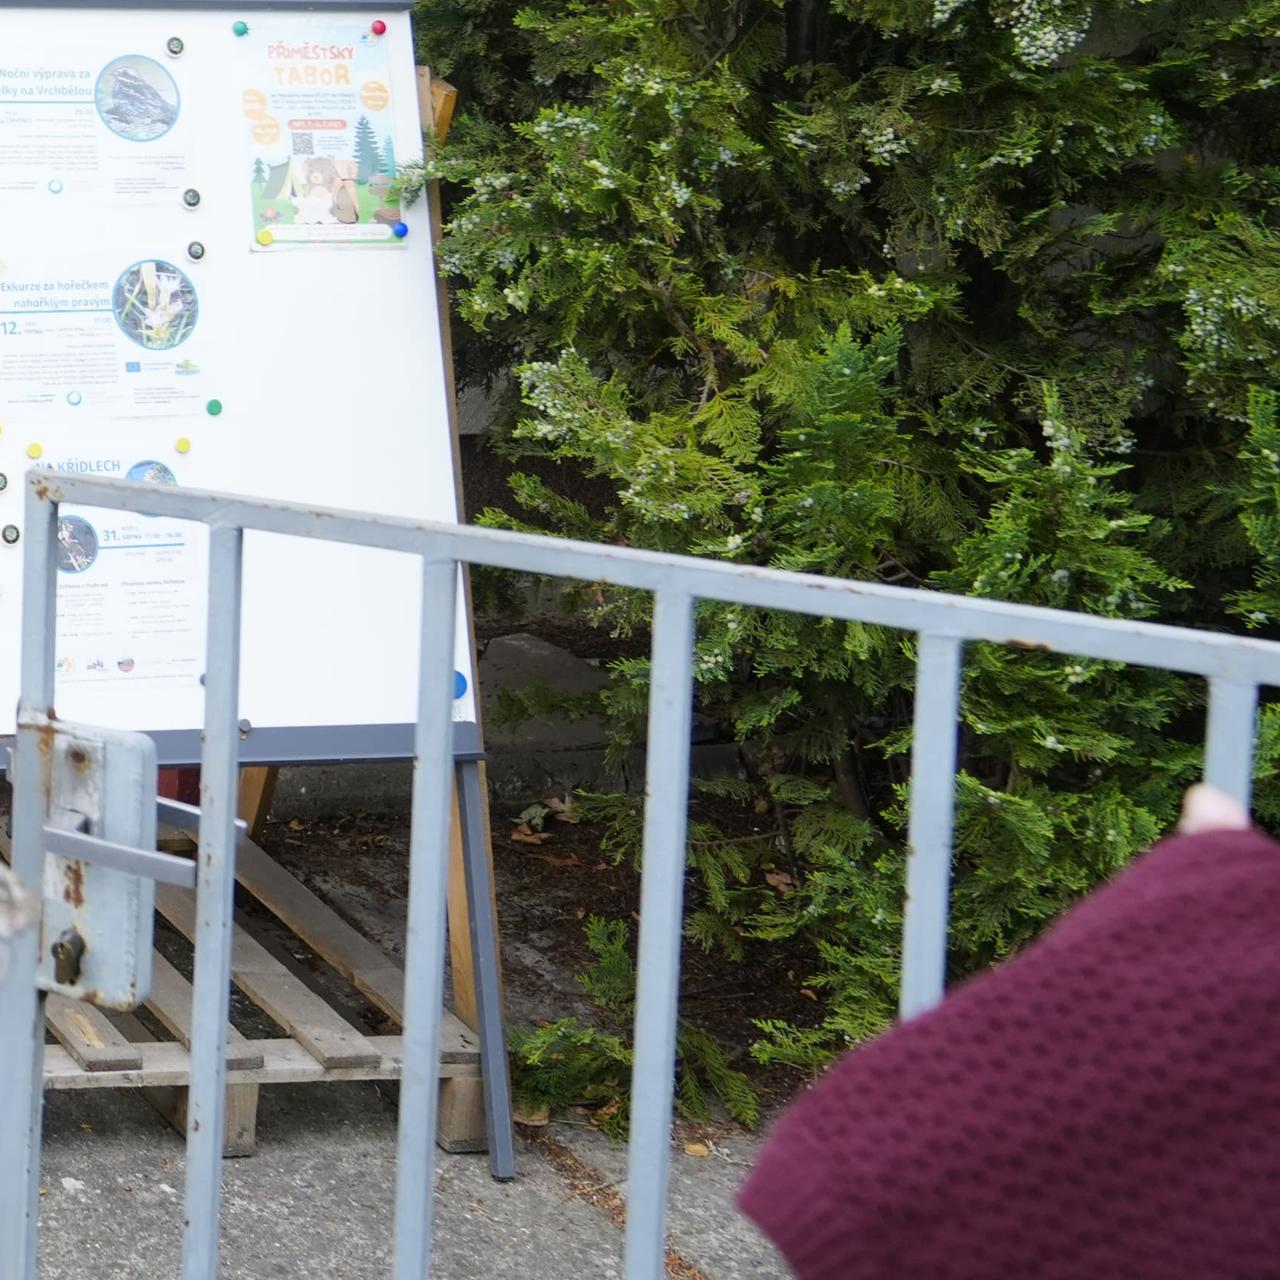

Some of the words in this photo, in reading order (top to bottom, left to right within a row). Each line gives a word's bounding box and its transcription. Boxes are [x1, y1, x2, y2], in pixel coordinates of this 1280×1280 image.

[0, 68, 30, 79] Noční
[33, 69, 76, 80] výprava
[79, 71, 90, 79] za
[21, 88, 34, 96] na
[37, 85, 92, 96] Vrchbělou
[0, 282, 40, 292] Exkurze
[43, 283, 55, 291] za
[58, 280, 109, 290] hořečkem
[14, 297, 69, 309] nahořklým
[71, 297, 110, 308] pravým
[1, 322, 21, 336] 12.
[103, 530, 120, 542] 31.
